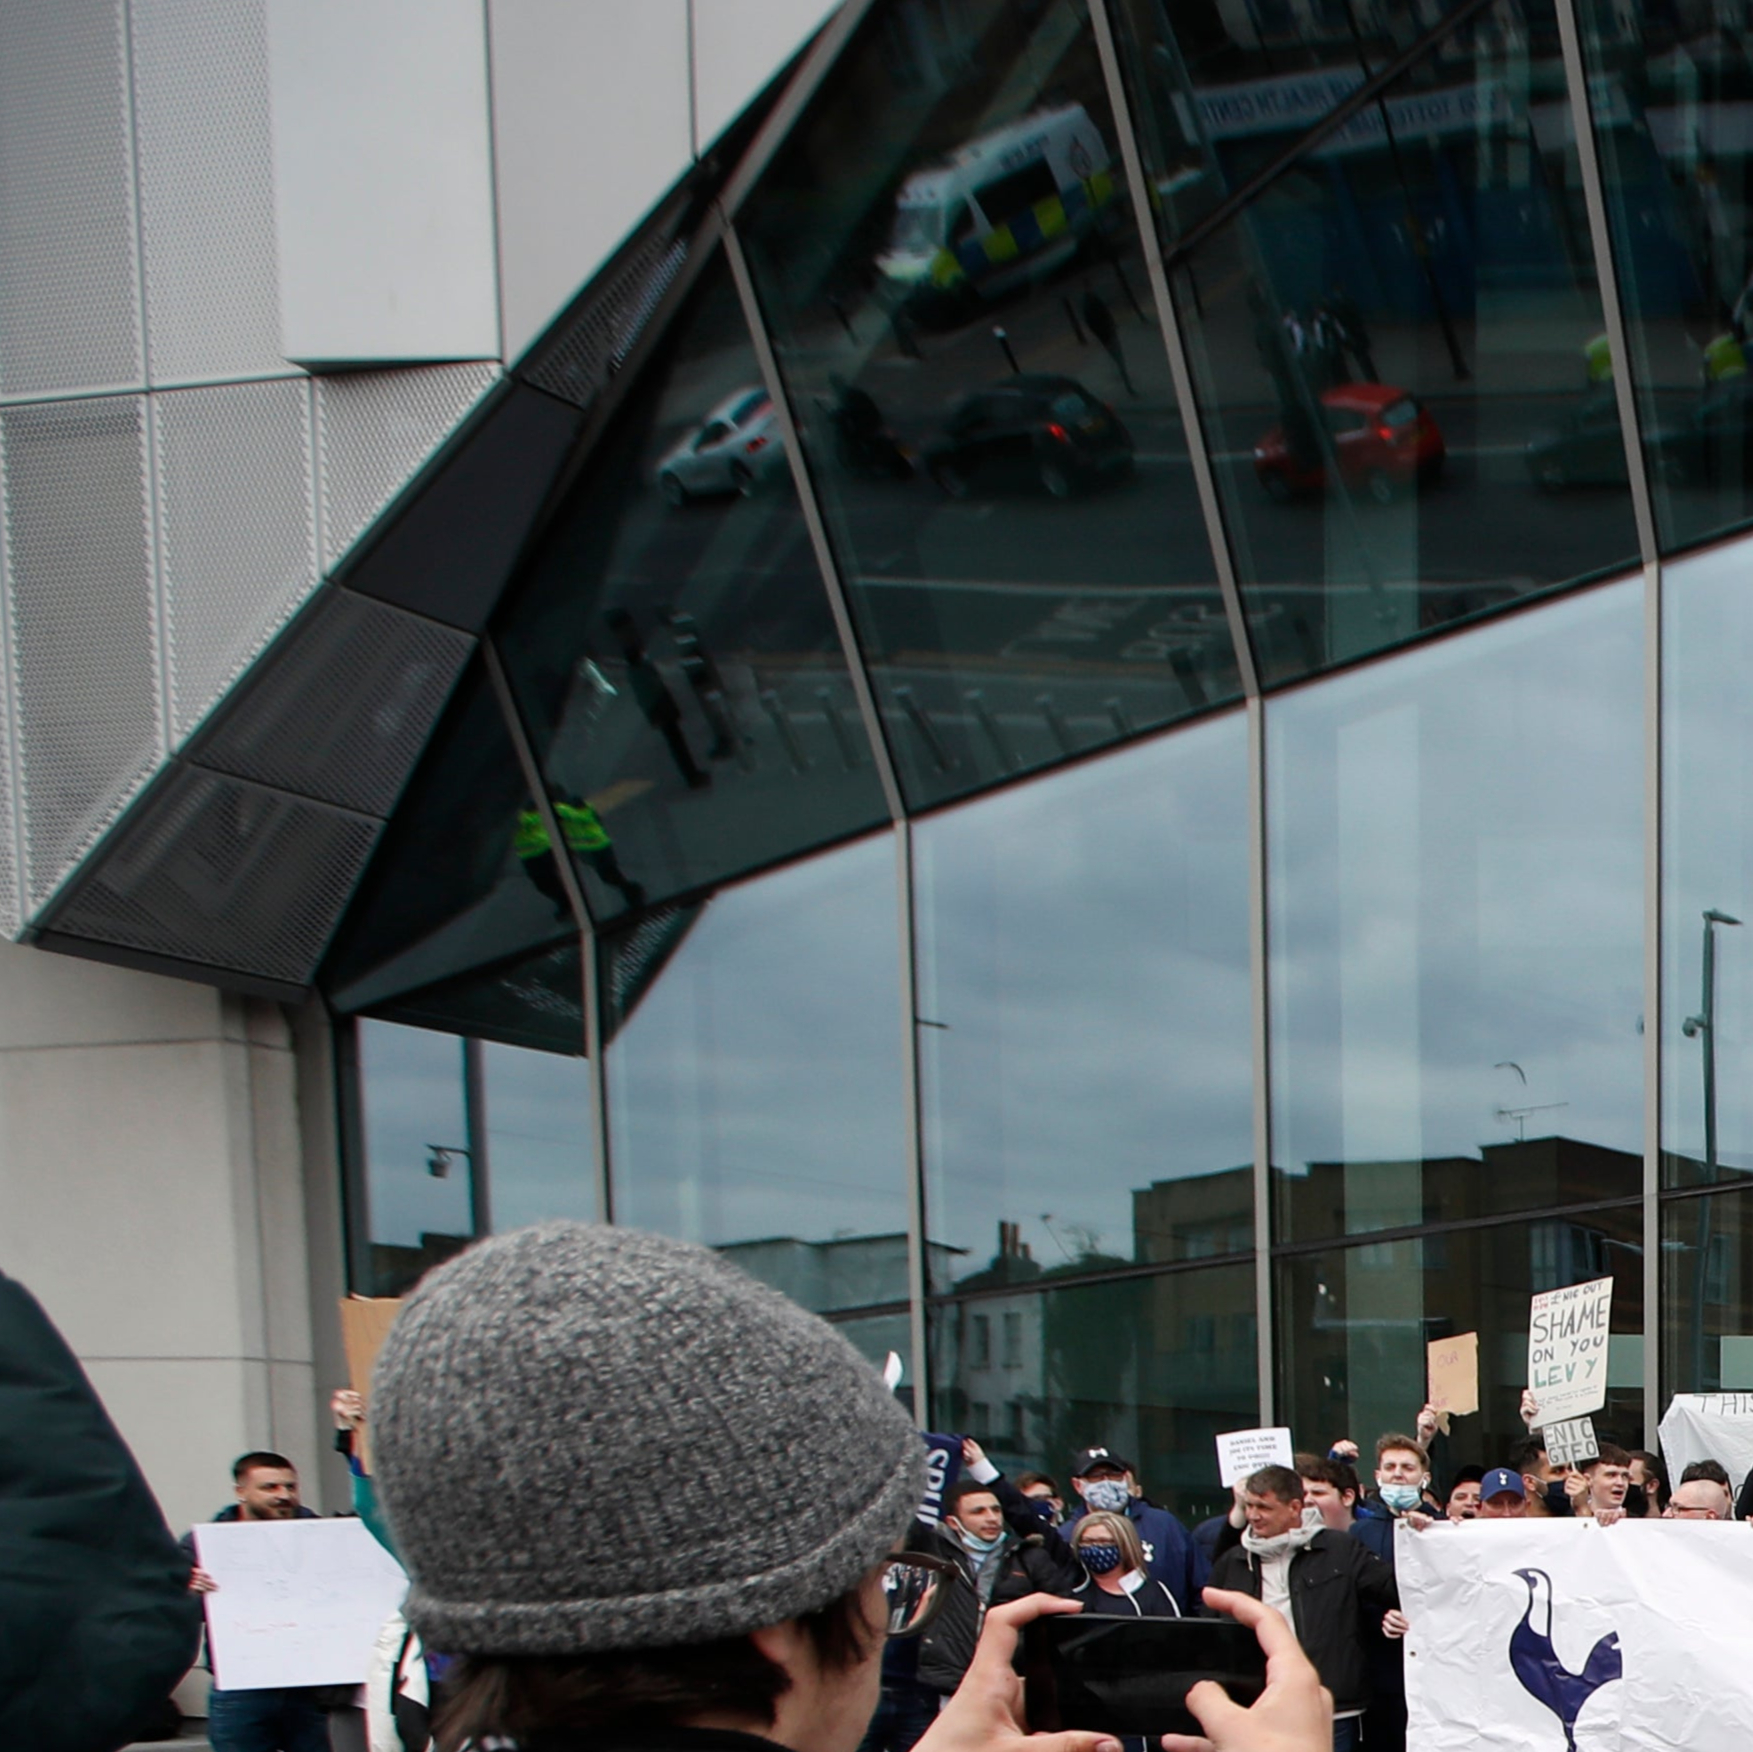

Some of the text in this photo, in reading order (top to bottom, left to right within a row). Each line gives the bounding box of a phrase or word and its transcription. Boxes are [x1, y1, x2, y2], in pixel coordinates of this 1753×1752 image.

[1533, 1294, 1610, 1343] SHAME
[1533, 1335, 1604, 1364] ON YOU
[1535, 1357, 1598, 1389] LEVY
[1548, 1440, 1597, 1464] GTFO
